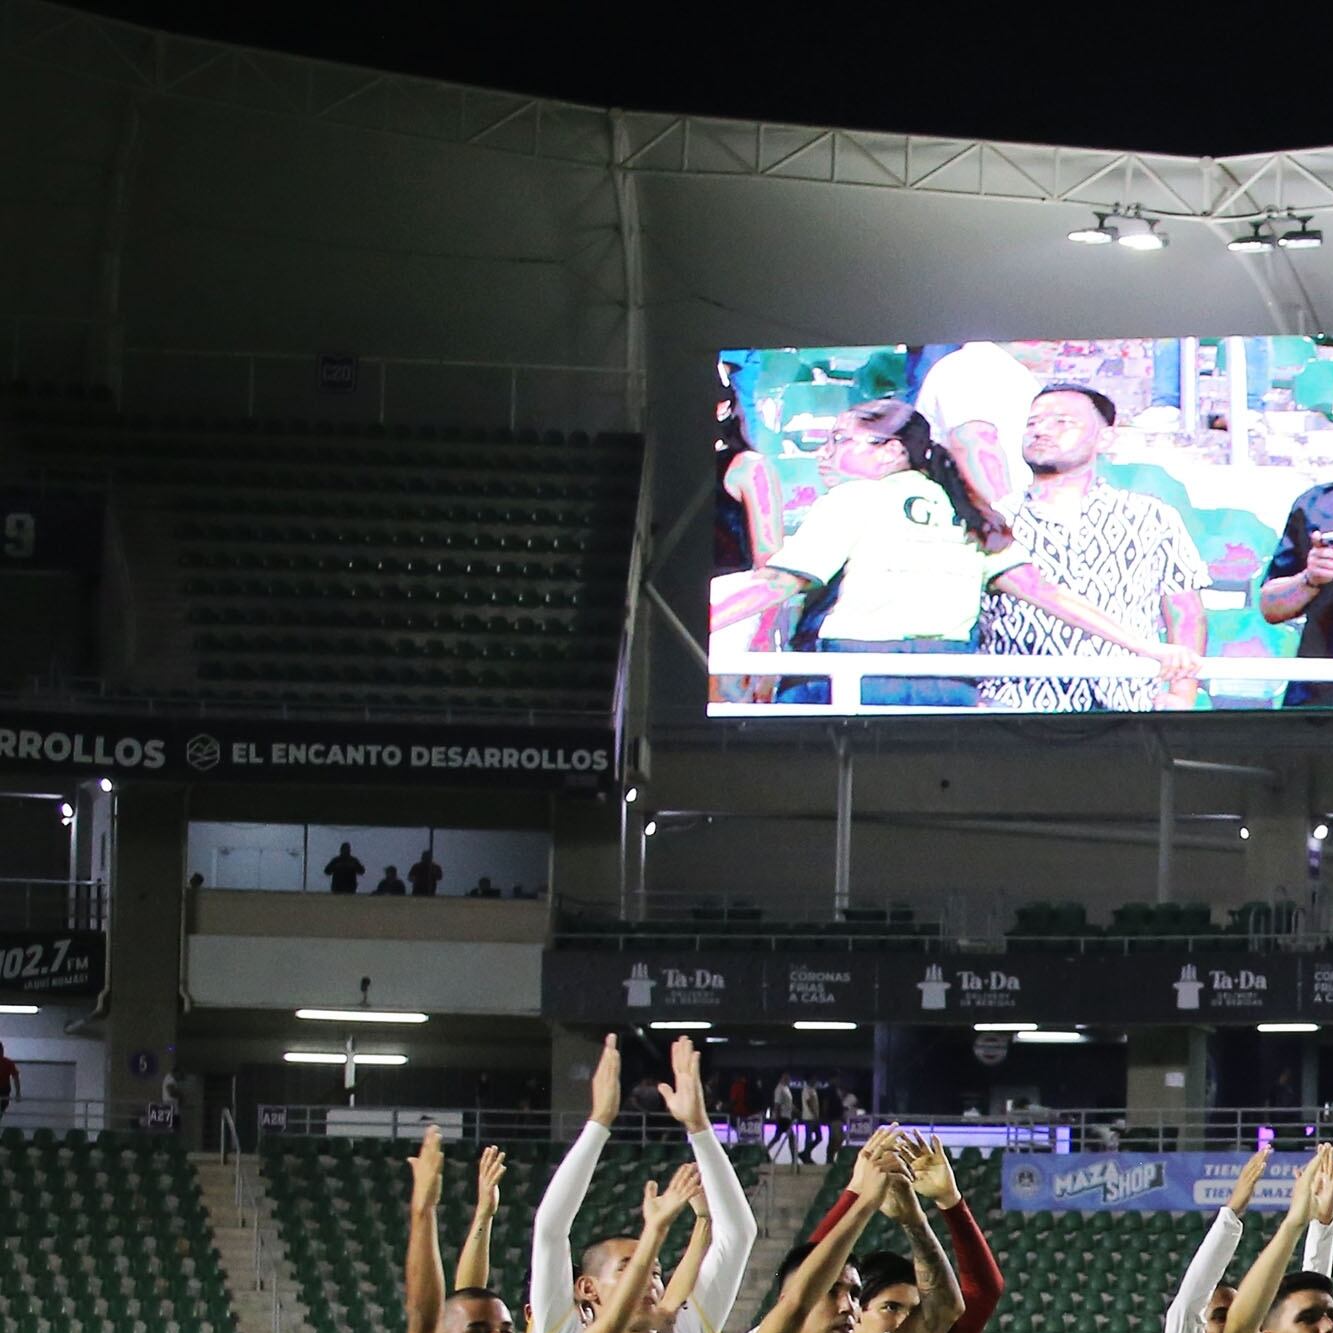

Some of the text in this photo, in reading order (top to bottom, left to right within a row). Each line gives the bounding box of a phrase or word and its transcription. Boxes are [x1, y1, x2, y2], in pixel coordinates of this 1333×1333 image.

[232, 742, 609, 772] EL ENCANTO DESARROLLOS
[1053, 1159, 1156, 1203] MAZA SHOP
